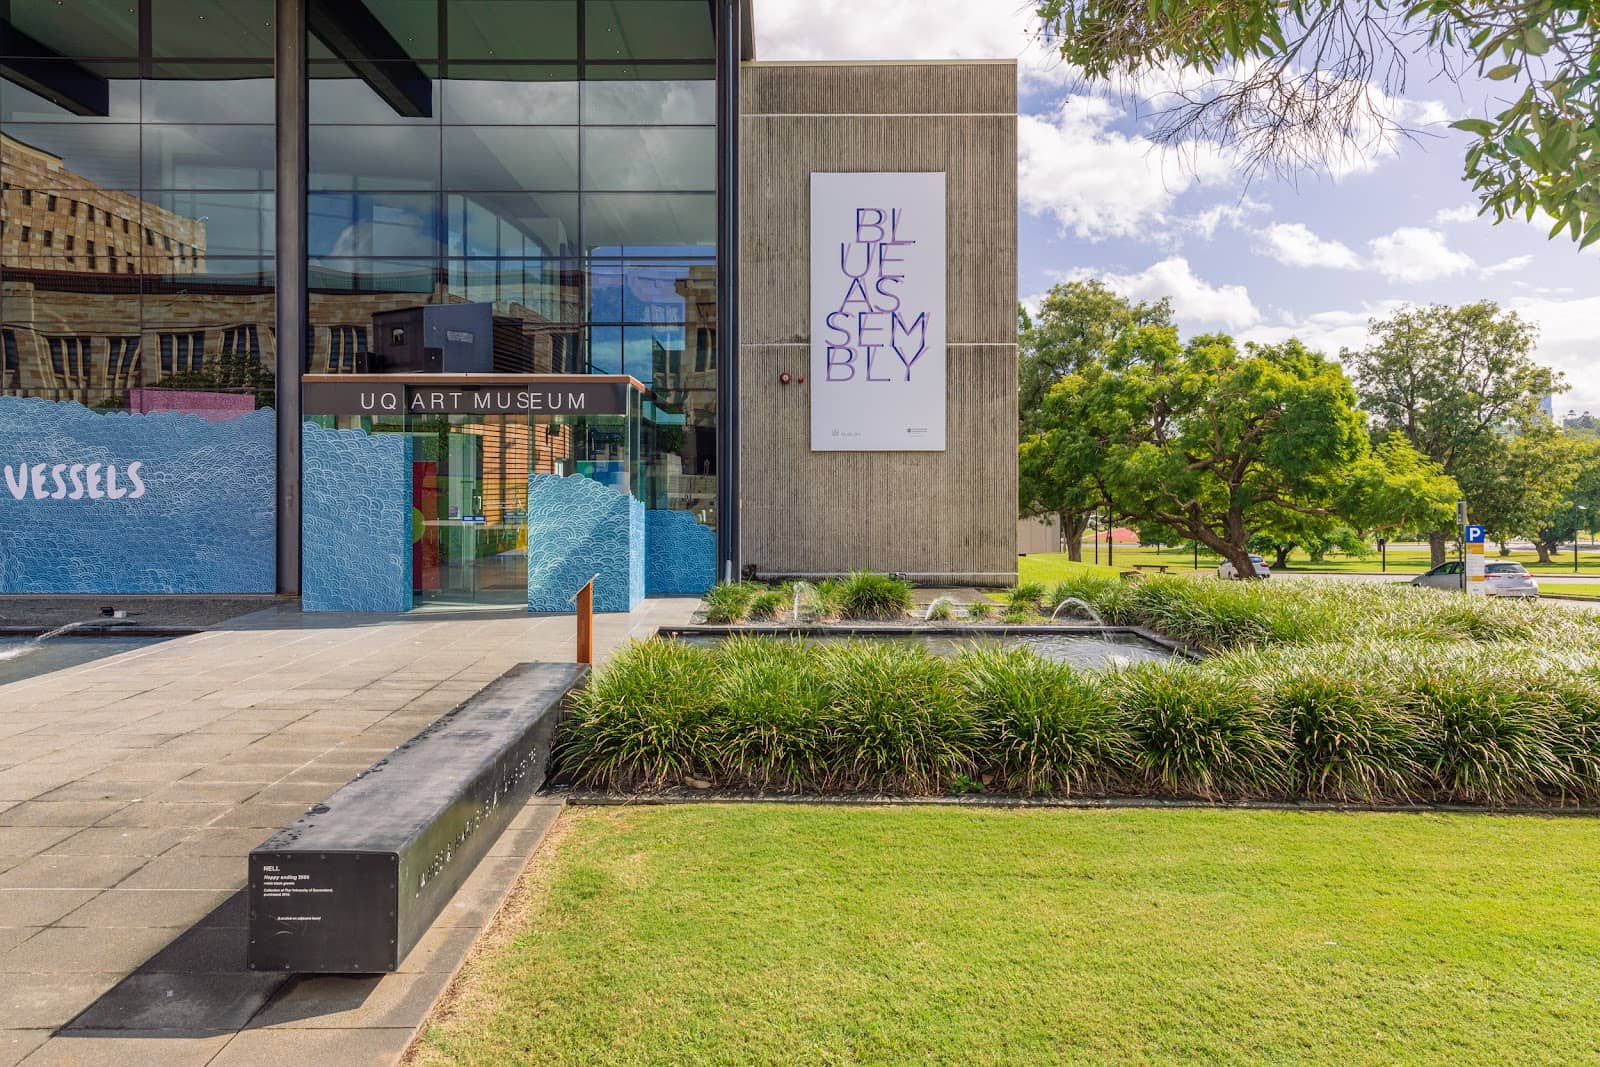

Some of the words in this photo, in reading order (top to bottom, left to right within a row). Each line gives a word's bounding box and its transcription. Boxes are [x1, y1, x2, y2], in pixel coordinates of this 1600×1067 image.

[856, 207, 916, 243] BL
[841, 242, 908, 278] UE
[838, 277, 904, 312] AS
[825, 311, 931, 347] SEM
[826, 346, 931, 382] BLY
[360, 392, 397, 410] UQ
[411, 392, 462, 409] ART
[474, 392, 585, 410] MUSEUM
[4, 461, 145, 500] VESSELS
[1469, 527, 1481, 541] P
